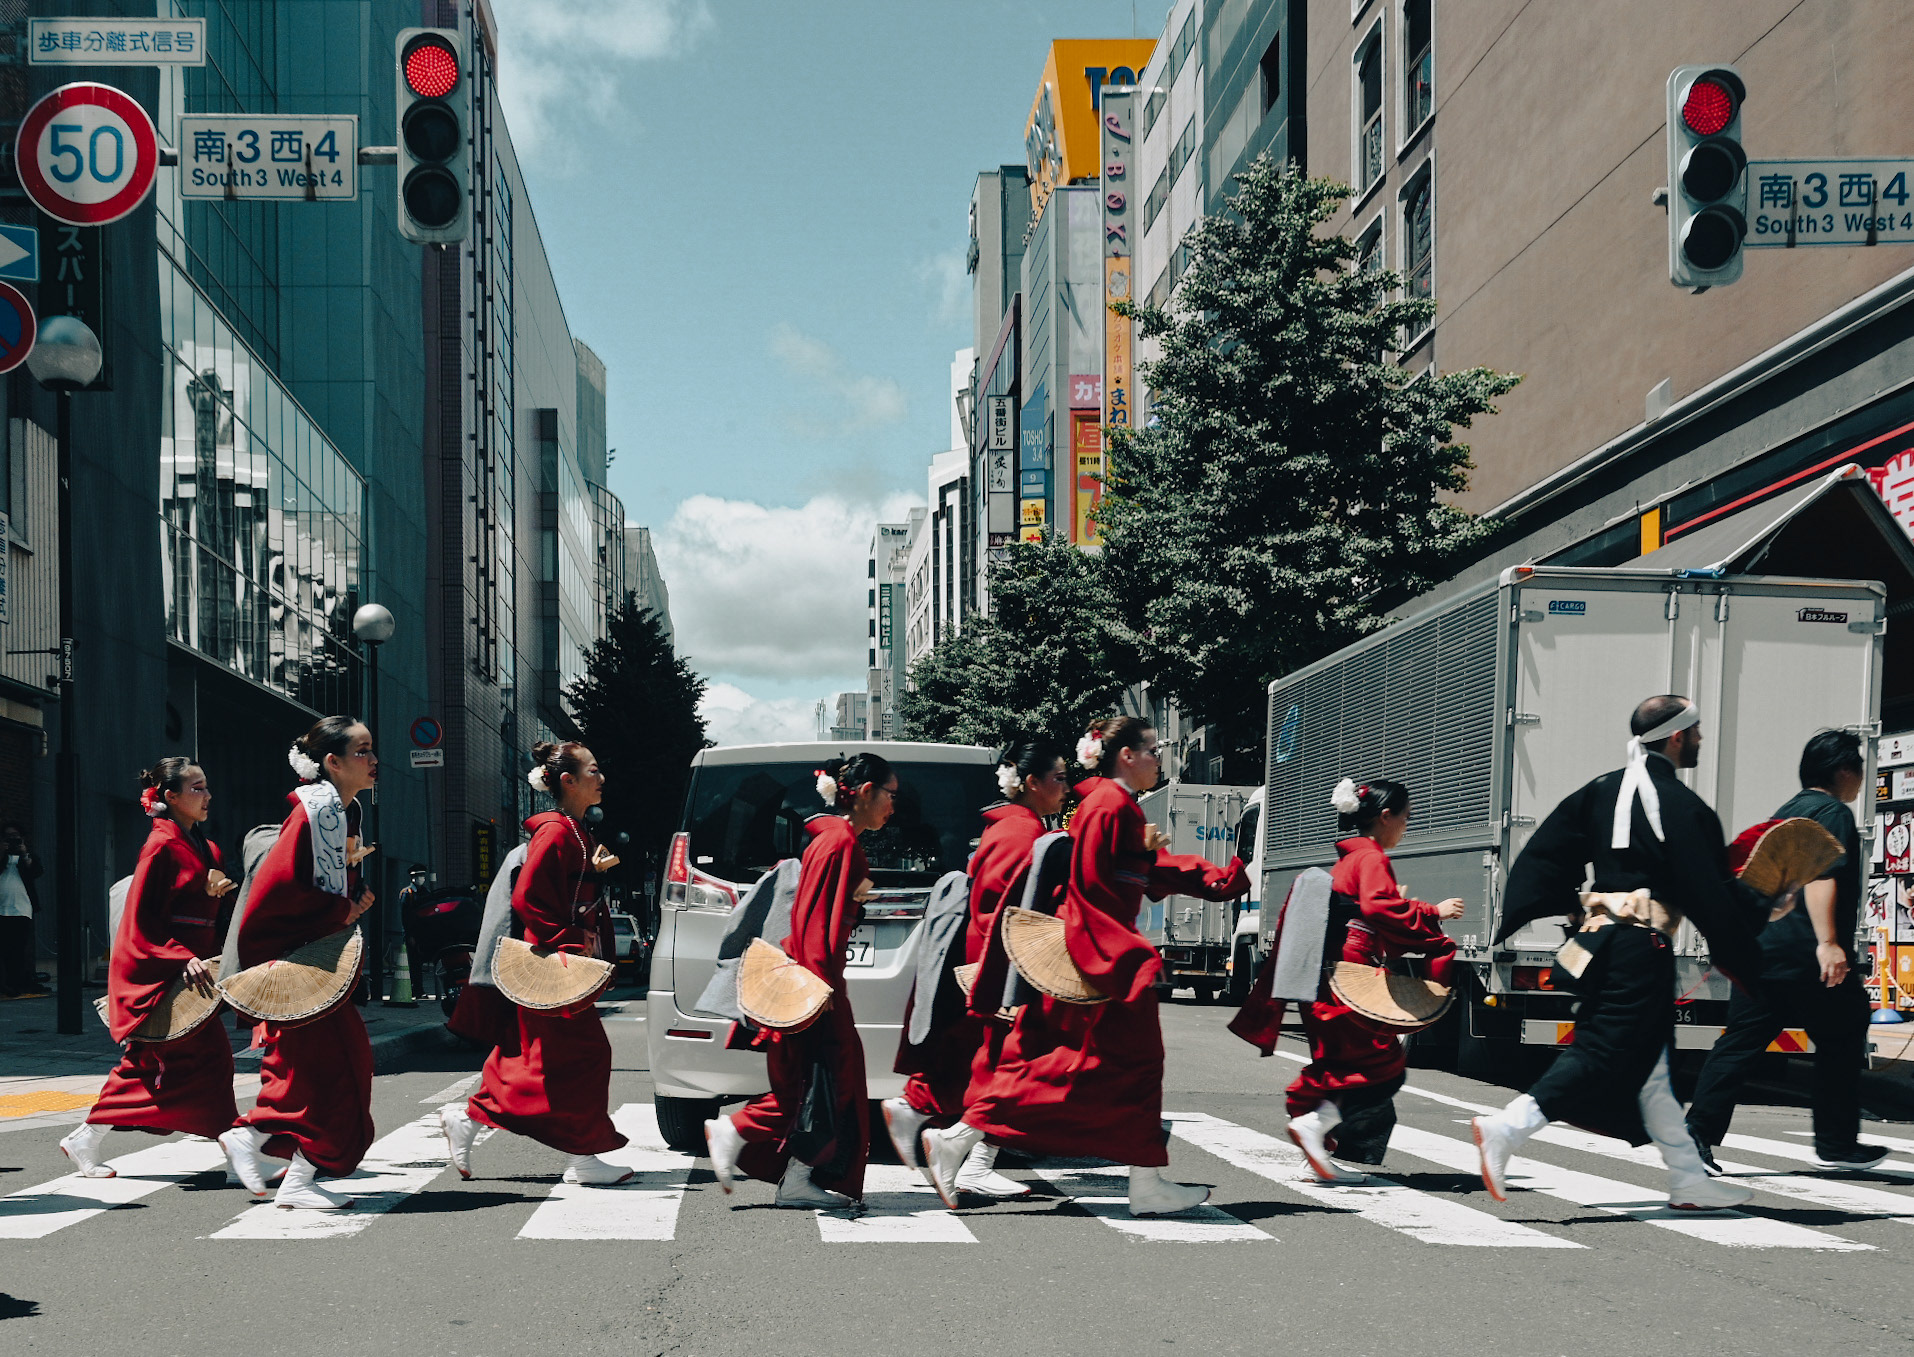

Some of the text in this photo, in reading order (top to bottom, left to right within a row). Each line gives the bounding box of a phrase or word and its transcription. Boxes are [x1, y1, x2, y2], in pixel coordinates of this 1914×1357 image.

[38, 31, 196, 52] 歩車分離式信号
[50, 125, 123, 183] 50
[193, 129, 340, 163] 南3西4
[192, 168, 252, 187] South
[276, 168, 327, 187] West
[1759, 172, 1910, 209] 南3西4
[1755, 214, 1818, 235] South
[1844, 213, 1896, 232] West
[57, 226, 85, 319] スバー
[1109, 387, 1127, 429] まね
[1023, 429, 1043, 446] TOSHO
[1805, 613, 1846, 621] 日本フルハーフ
[1196, 825, 1236, 841] SAG
[1676, 1009, 1691, 1022] 36
